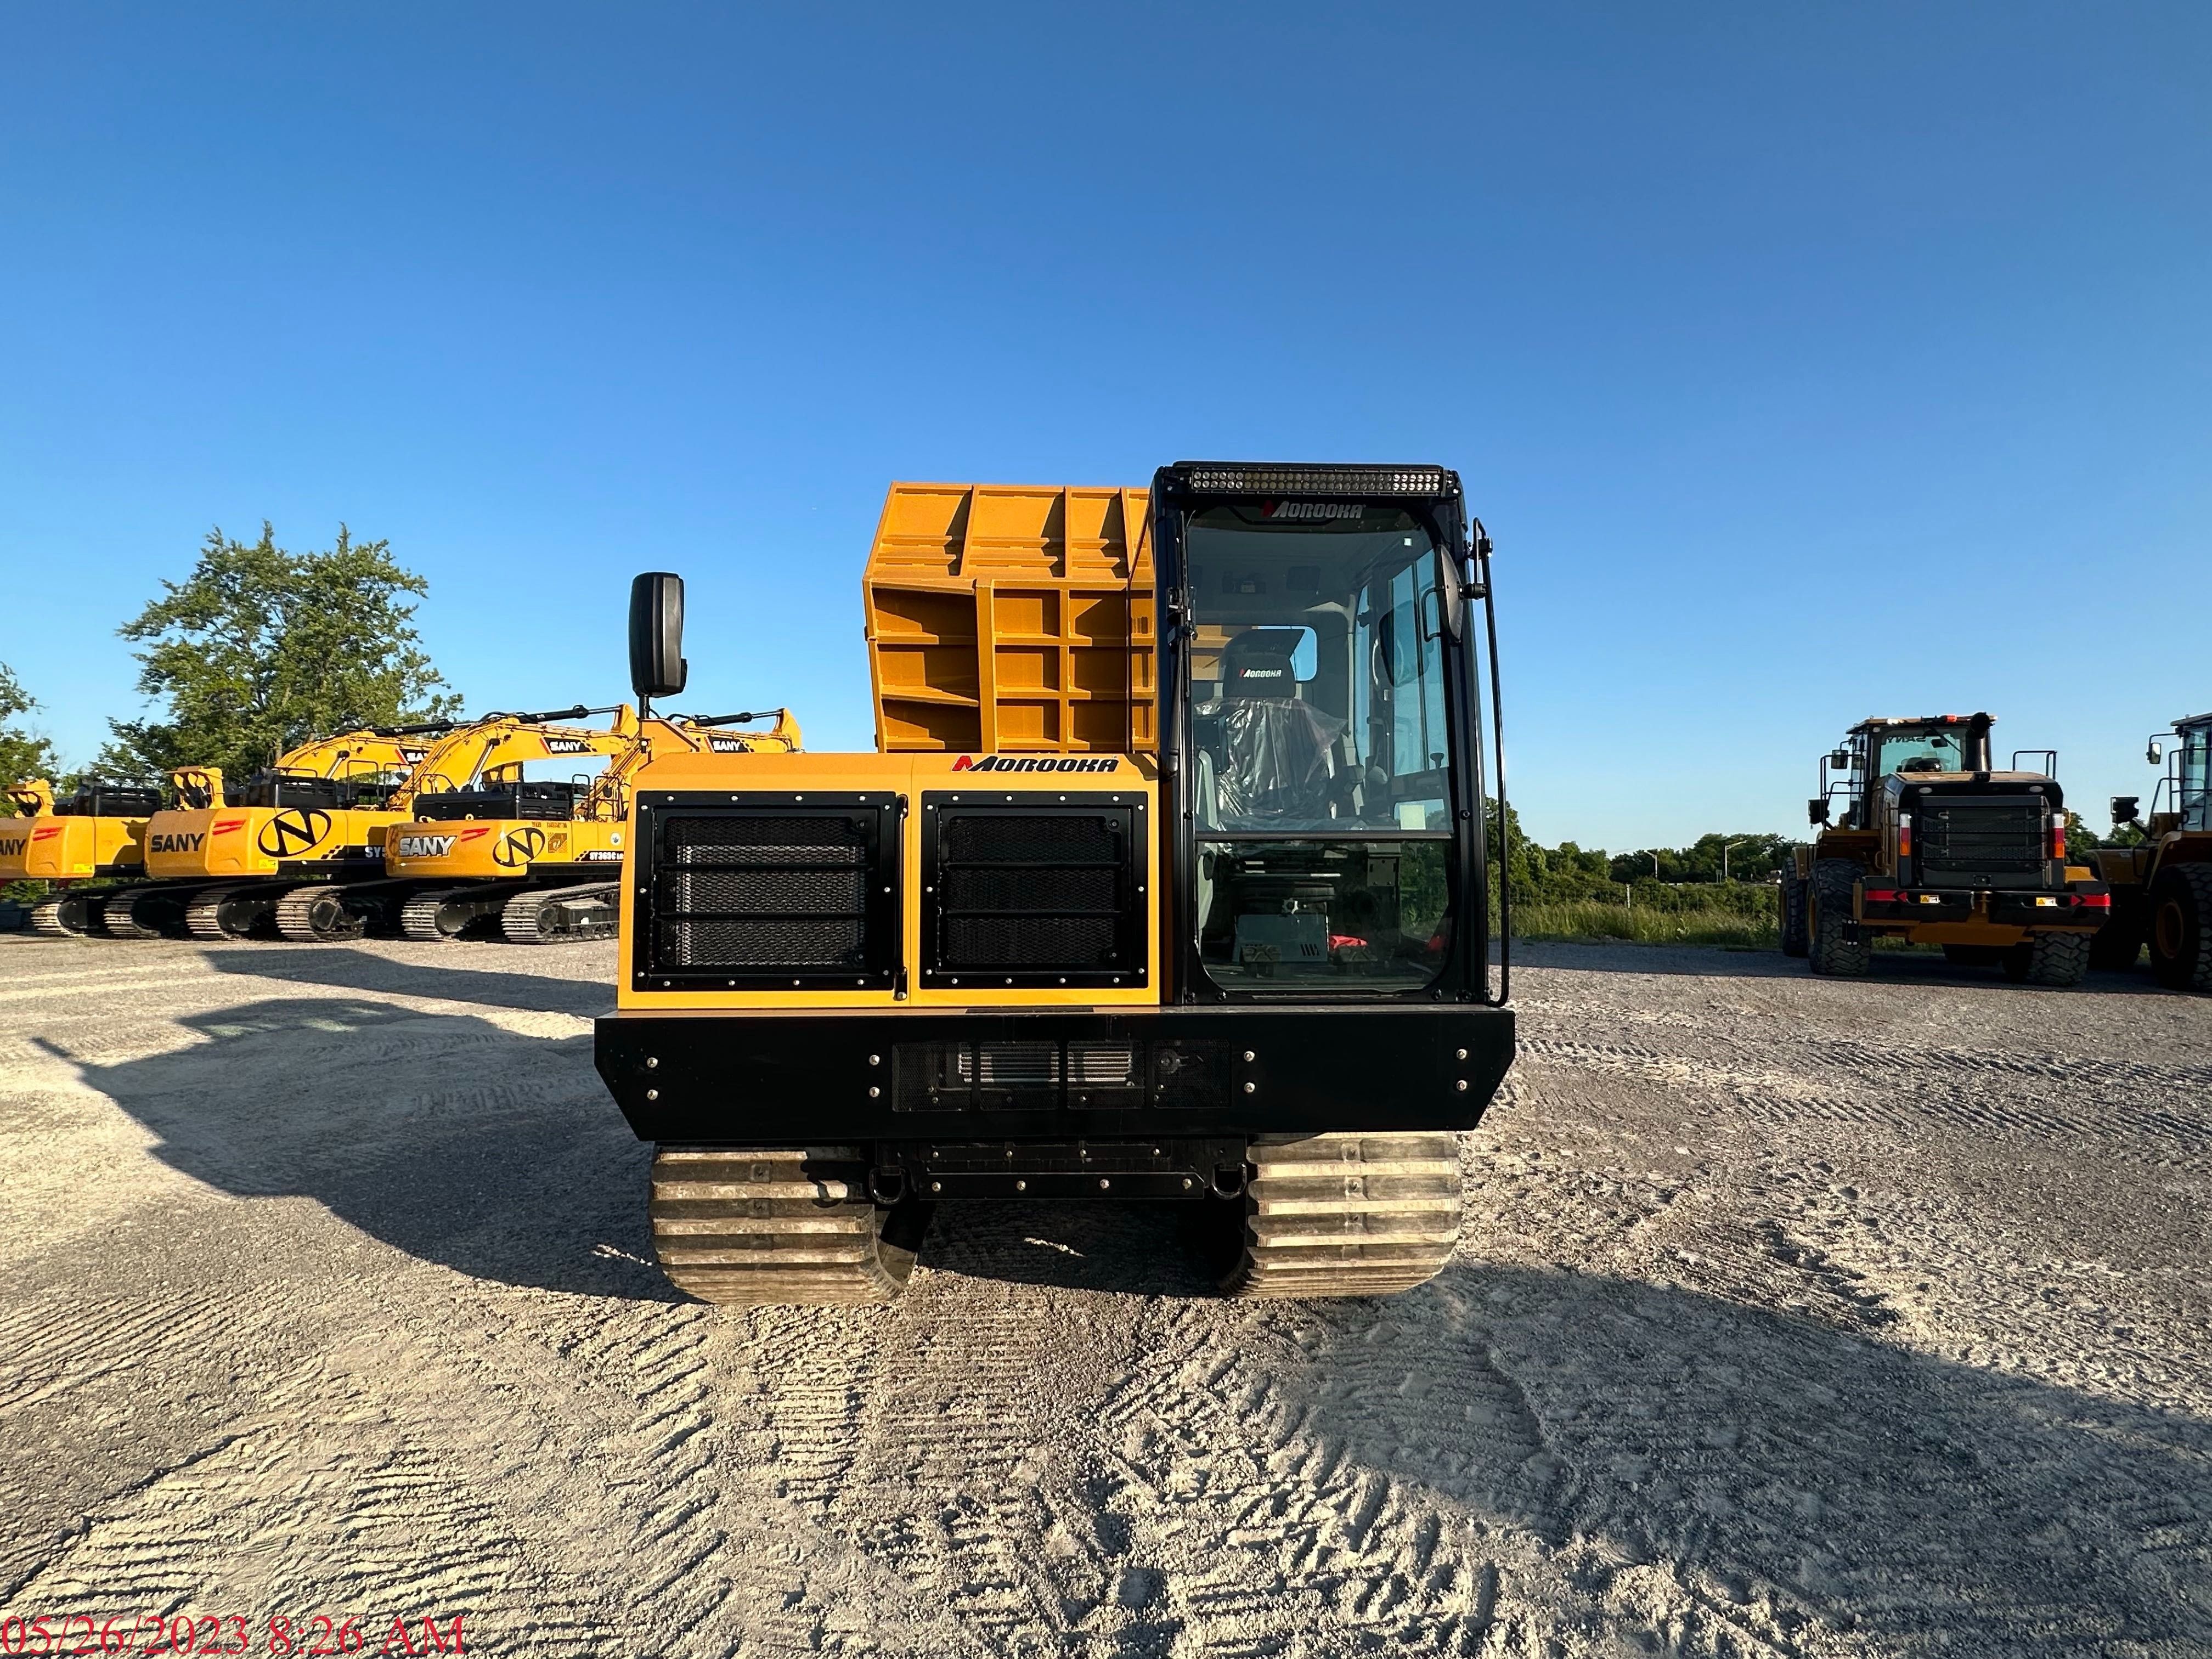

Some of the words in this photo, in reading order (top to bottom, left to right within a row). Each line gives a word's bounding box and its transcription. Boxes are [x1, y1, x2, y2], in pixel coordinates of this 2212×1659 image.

[1261, 500, 1364, 518] MOROOKA
[1239, 668, 1282, 678] MOROOKA
[550, 741, 581, 751] SANY
[713, 741, 741, 751] SANY
[951, 755, 1119, 772] MOROOKA
[150, 832, 206, 853] SANY
[399, 836, 458, 857] SANY
